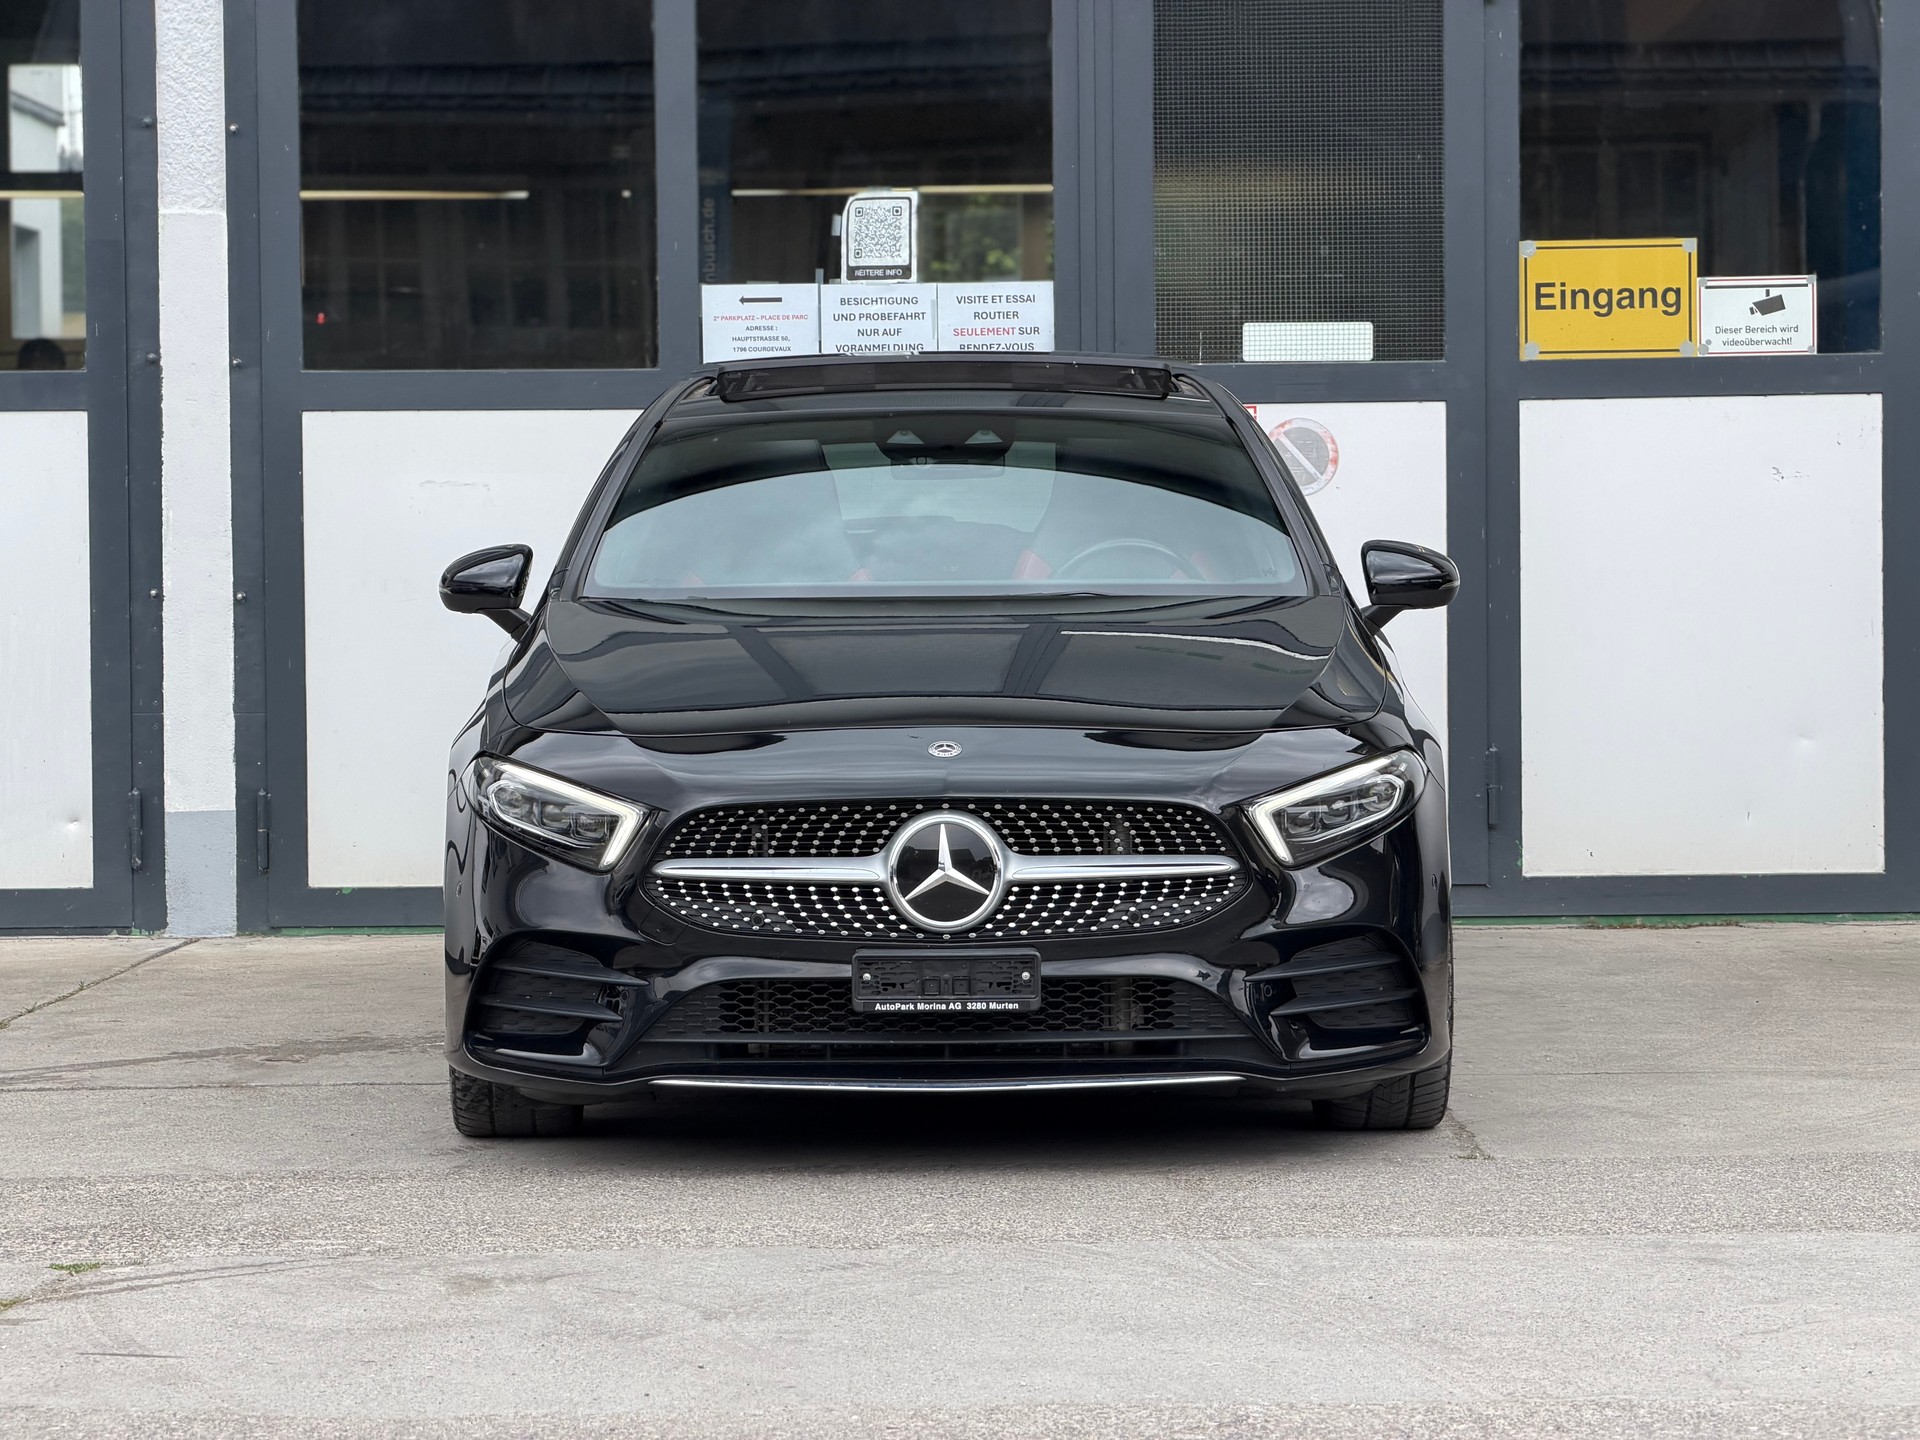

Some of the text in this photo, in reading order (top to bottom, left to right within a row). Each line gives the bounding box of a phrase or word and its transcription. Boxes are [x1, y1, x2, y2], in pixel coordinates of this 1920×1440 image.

[886, 268, 903, 276] INFO
[840, 296, 919, 306] BESICHTIGUNG
[956, 294, 1036, 304] VISITE ET ESSAI
[1535, 282, 1682, 317] Eingang
[833, 312, 926, 321] UND PROBEFAHRT
[974, 311, 1020, 320] ROUTIER
[857, 328, 902, 337] NUR AUF
[953, 327, 1040, 336] SEULEMENT SUR
[1715, 325, 1799, 334] Dieser Bereich wird
[1722, 337, 1792, 346] videoüberwacht!
[835, 343, 924, 352] VORANMELDUNG
[959, 343, 1034, 351] RENDEZ-VOUS
[875, 1002, 914, 1010] AutoPark
[917, 1002, 946, 1010] Morina
[948, 1002, 962, 1010] AG
